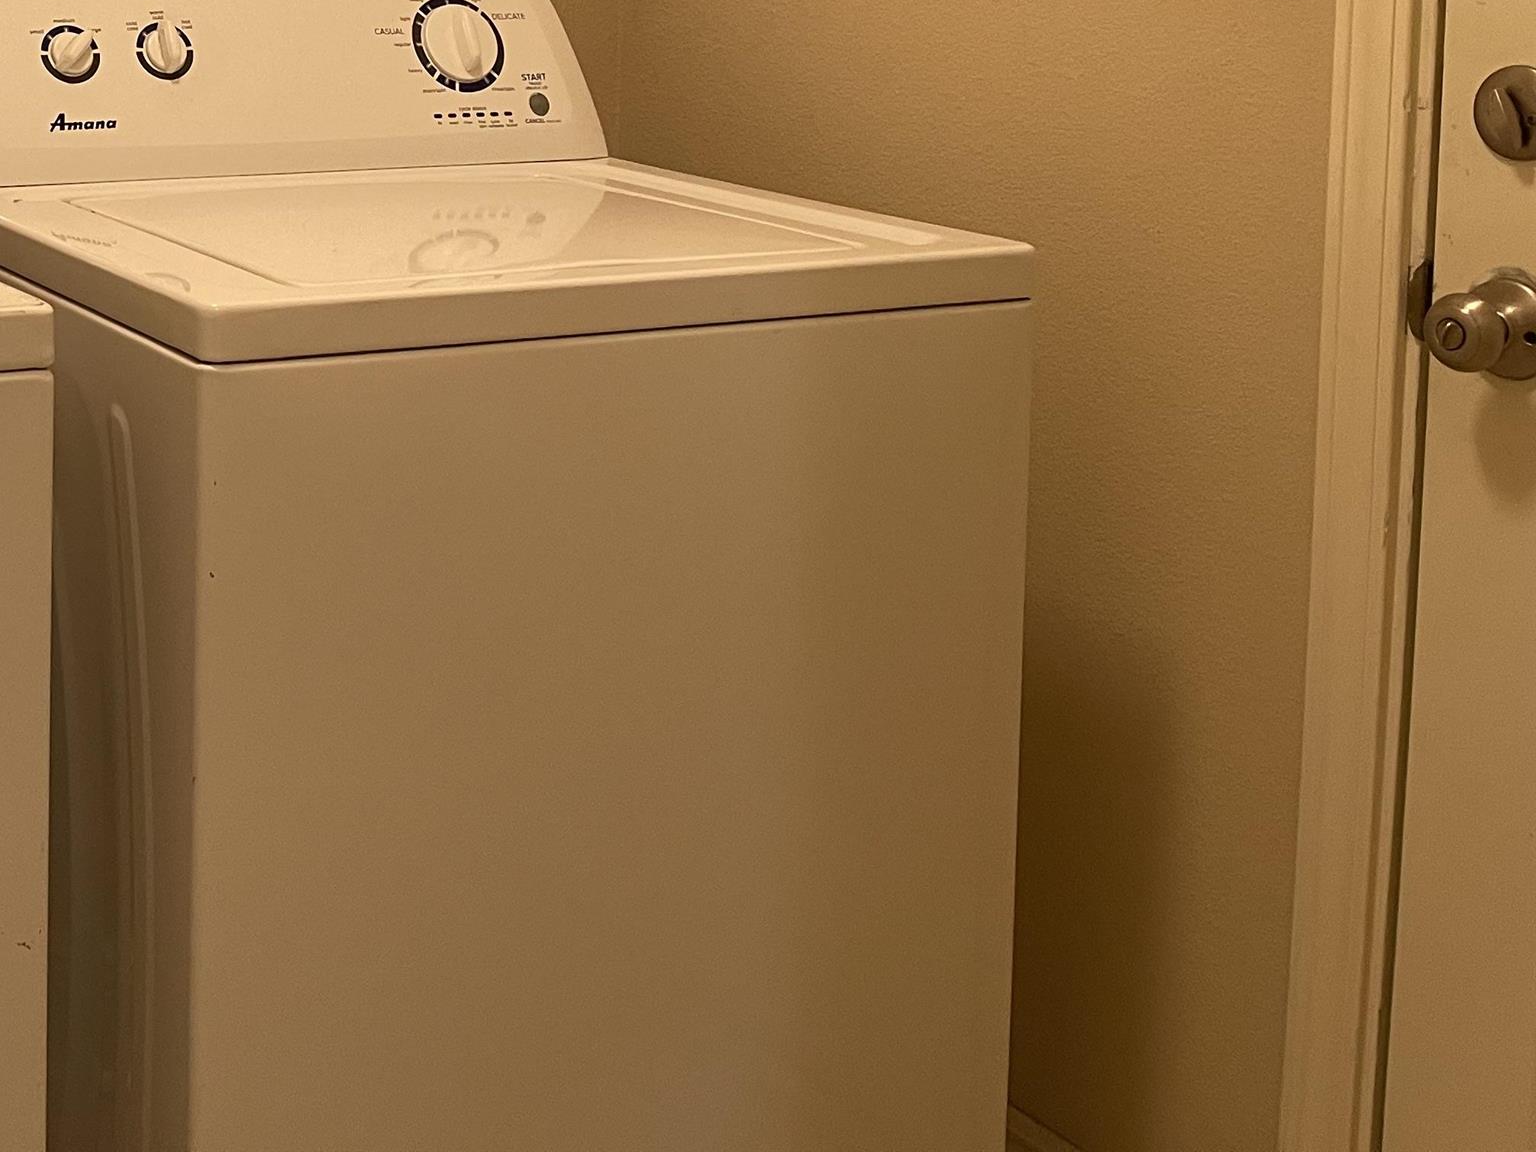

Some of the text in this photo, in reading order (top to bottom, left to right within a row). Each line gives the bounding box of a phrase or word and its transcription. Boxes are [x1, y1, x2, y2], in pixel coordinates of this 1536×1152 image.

[491, 12, 526, 20] DELICATE
[374, 27, 405, 35] CASUAL
[521, 73, 546, 81] START
[49, 113, 117, 132] Amana
